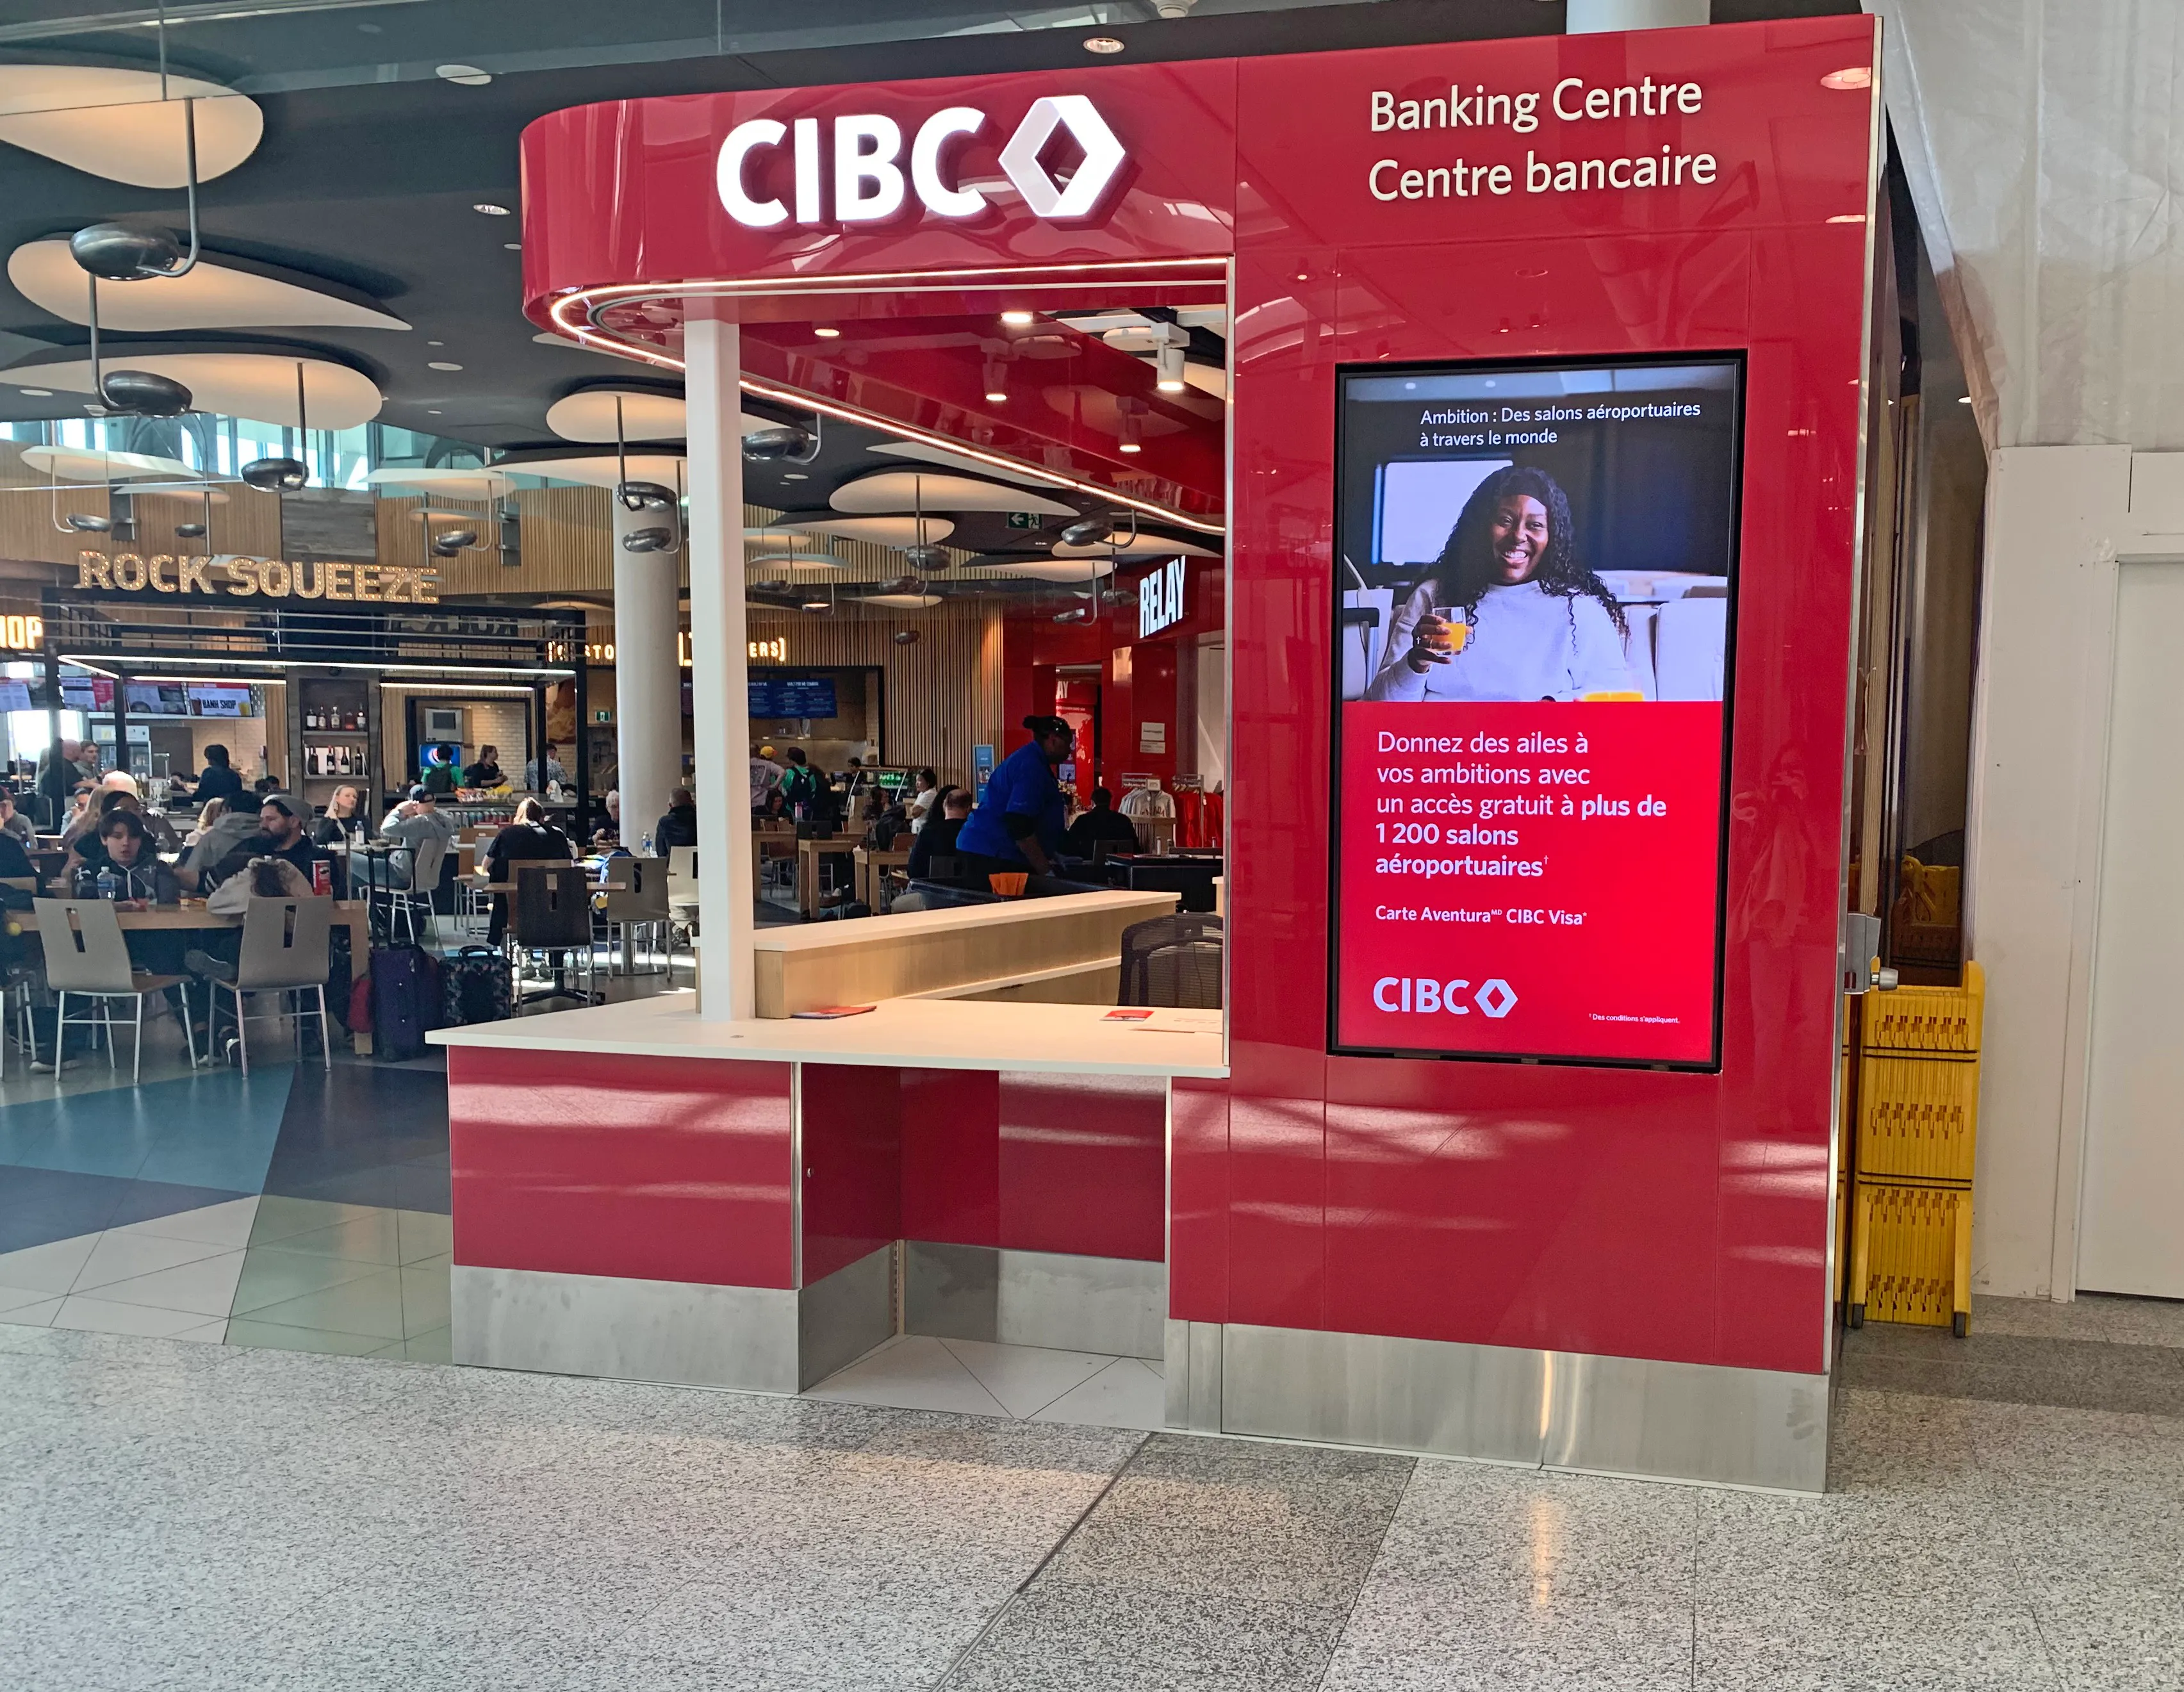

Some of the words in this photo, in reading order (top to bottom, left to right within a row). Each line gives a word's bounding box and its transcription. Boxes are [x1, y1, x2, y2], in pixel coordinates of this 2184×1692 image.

[1371, 84, 1540, 133] Banking
[1552, 76, 1702, 121] Centre
[716, 106, 987, 227] CIBC
[1368, 158, 1513, 201] Centre
[1527, 144, 1717, 193] bancaire
[1420, 407, 1488, 425] Ambition
[1501, 407, 1531, 423] Des
[1534, 404, 1583, 422] salons
[1586, 401, 1701, 422] aéroportuaires
[1420, 432, 1429, 447] à
[1432, 432, 1484, 447] travers
[1488, 429, 1502, 446] le
[1506, 427, 1558, 445] monde
[79, 550, 216, 595] ROCK
[226, 557, 440, 604] SQUEEZE
[1139, 555, 1186, 639] RELAY
[1378, 731, 1463, 753] Donnez
[1470, 730, 1510, 753] des
[1516, 730, 1568, 753] ailes
[1575, 732, 1589, 753] à
[1377, 768, 1414, 784] vos
[1420, 761, 1531, 785] ambitions
[1538, 768, 1590, 785] avec
[1377, 797, 1404, 814] un
[1411, 793, 1473, 815] accès
[1479, 794, 1554, 818] gratuit
[1561, 795, 1573, 816] à
[1581, 794, 1630, 821] plus
[1637, 794, 1667, 817] de
[1446, 823, 1519, 846] salons
[1375, 905, 1417, 921] Carte
[1506, 908, 1545, 924] CIBC
[1373, 976, 1470, 1015] CIBC
[1606, 1014, 1639, 1023] conditions
